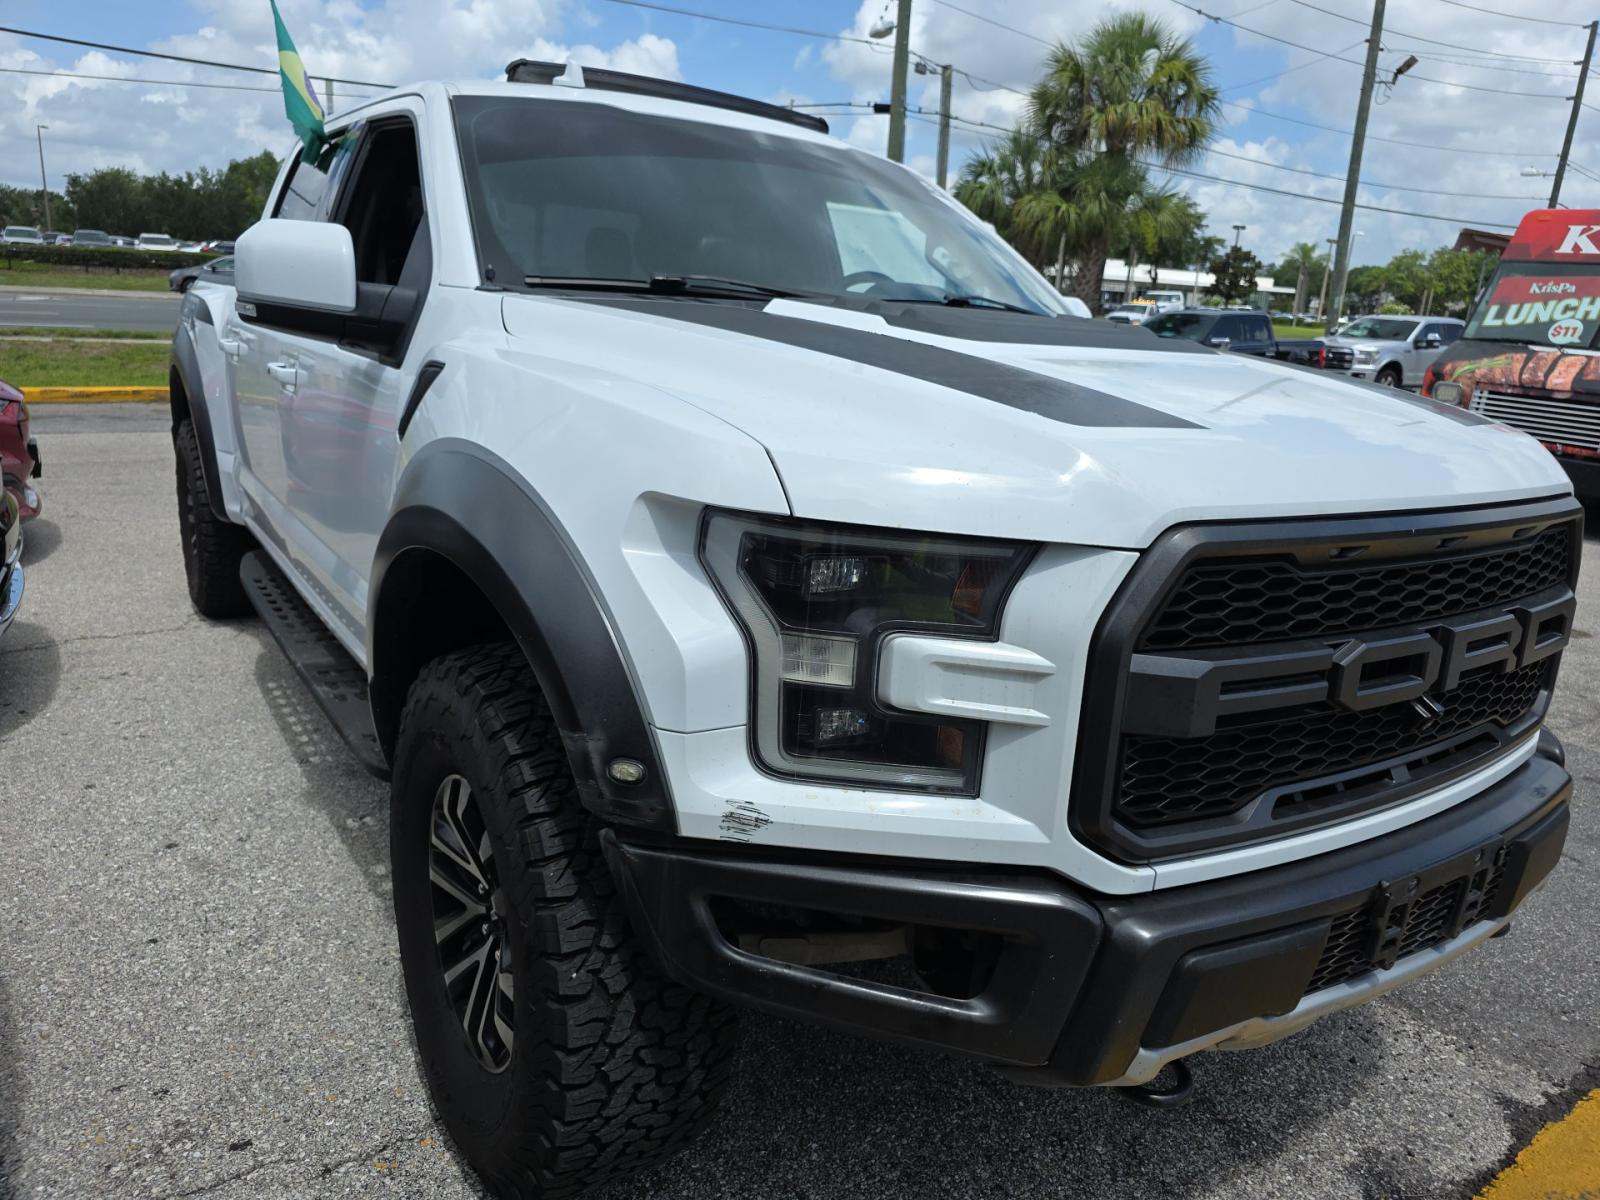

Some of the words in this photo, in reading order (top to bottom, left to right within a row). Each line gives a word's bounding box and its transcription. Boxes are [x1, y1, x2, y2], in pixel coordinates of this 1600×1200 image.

[1480, 296, 1600, 327] LUNCH
[1551, 324, 1579, 338] $11
[1128, 586, 1577, 738] FORD
